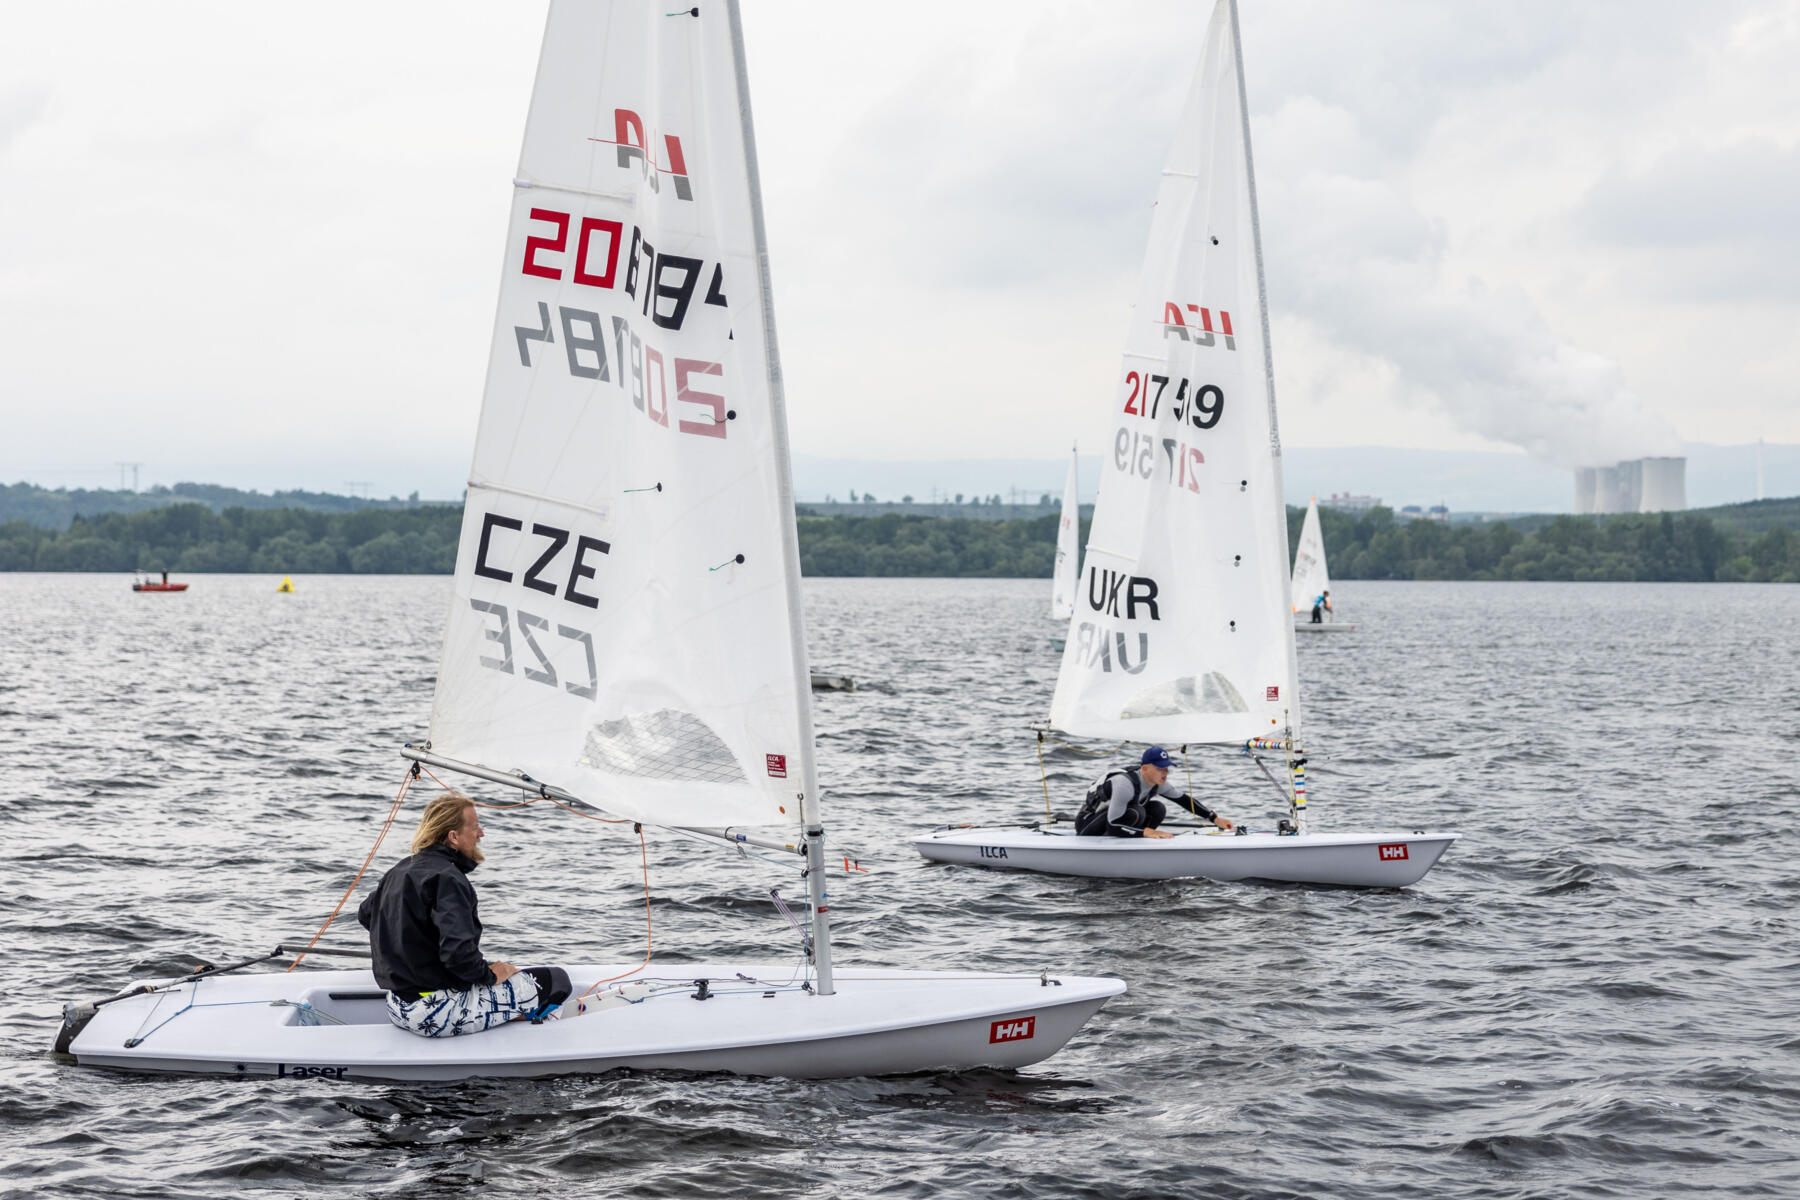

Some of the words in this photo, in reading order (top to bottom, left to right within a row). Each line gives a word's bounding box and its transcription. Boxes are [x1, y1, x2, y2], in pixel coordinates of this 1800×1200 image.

[474, 512, 611, 609] CZE
[1089, 566, 1160, 620] UKR
[980, 845, 1008, 859] ILCA
[1382, 846, 1405, 858] HH
[995, 1021, 1029, 1040] HH
[278, 1063, 348, 1079] Laser
